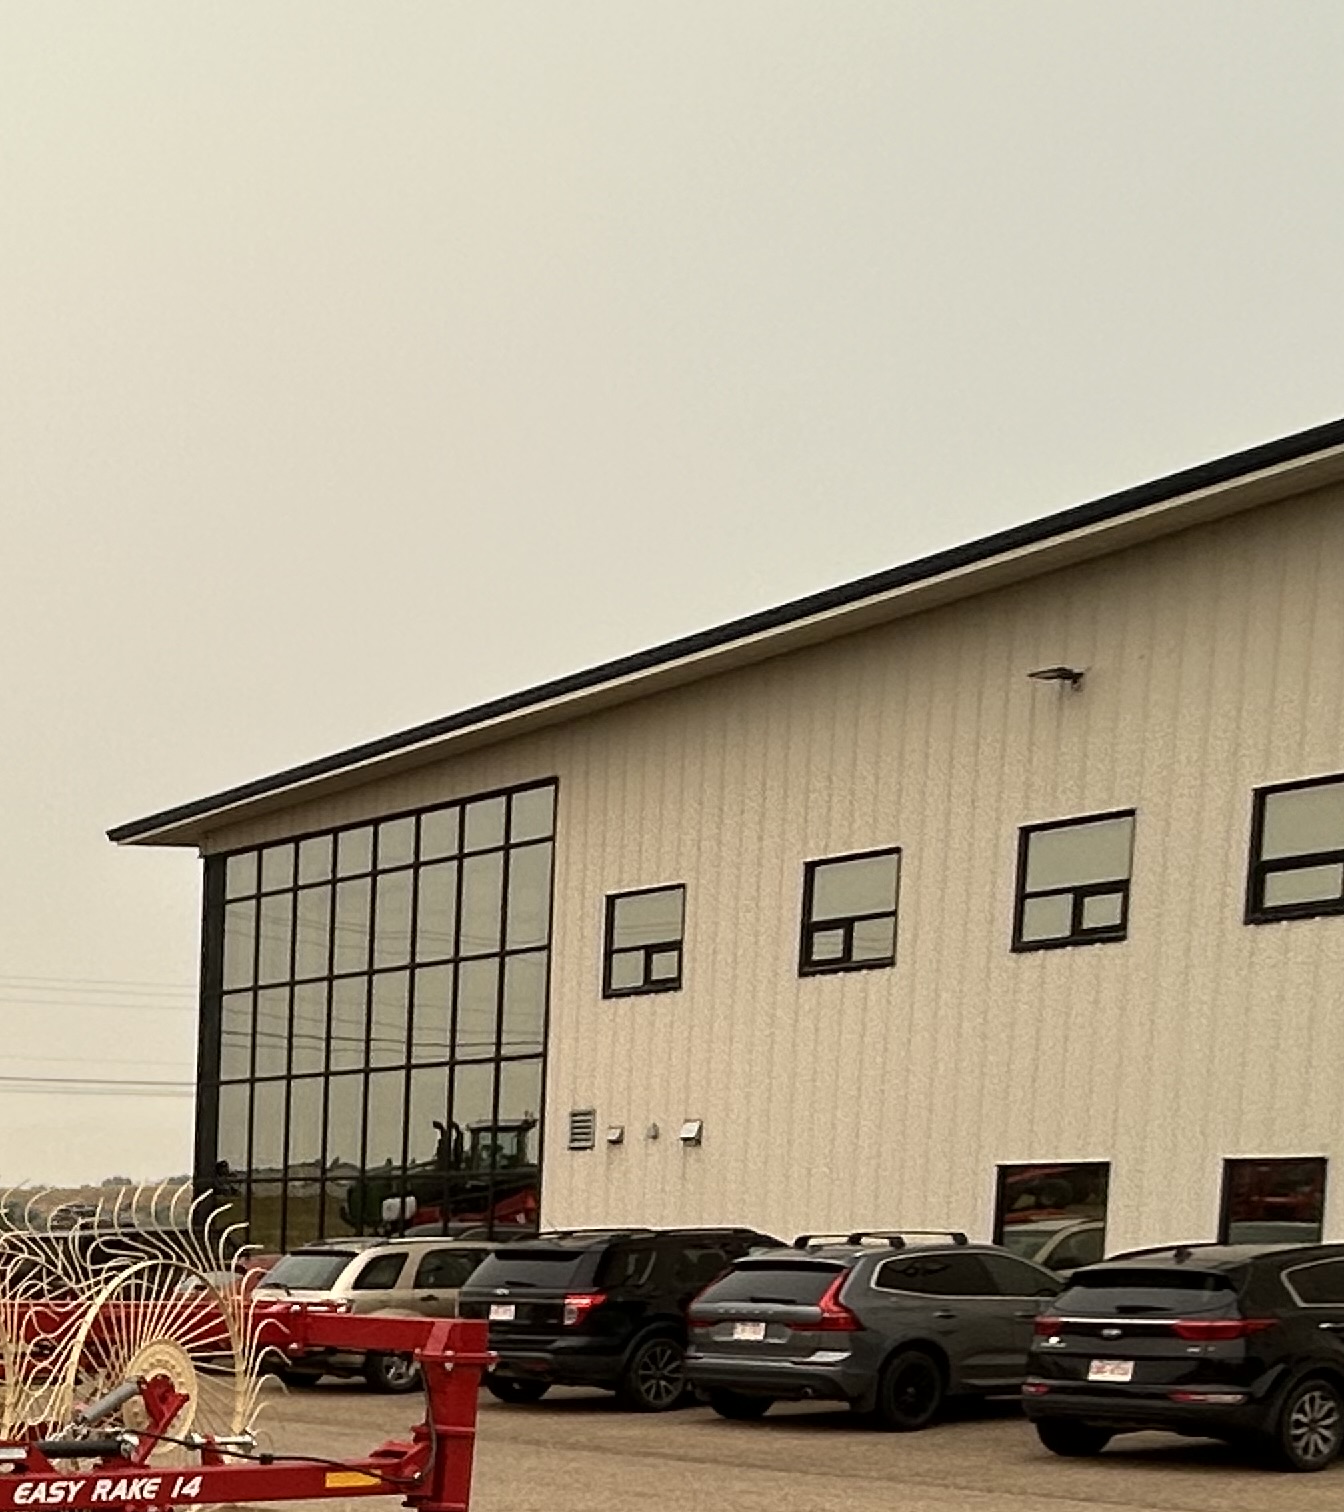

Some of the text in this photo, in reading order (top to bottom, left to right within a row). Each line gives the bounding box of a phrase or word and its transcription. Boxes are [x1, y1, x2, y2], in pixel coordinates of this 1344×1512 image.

[13, 1476, 203, 1504] EASY RAKE 14
